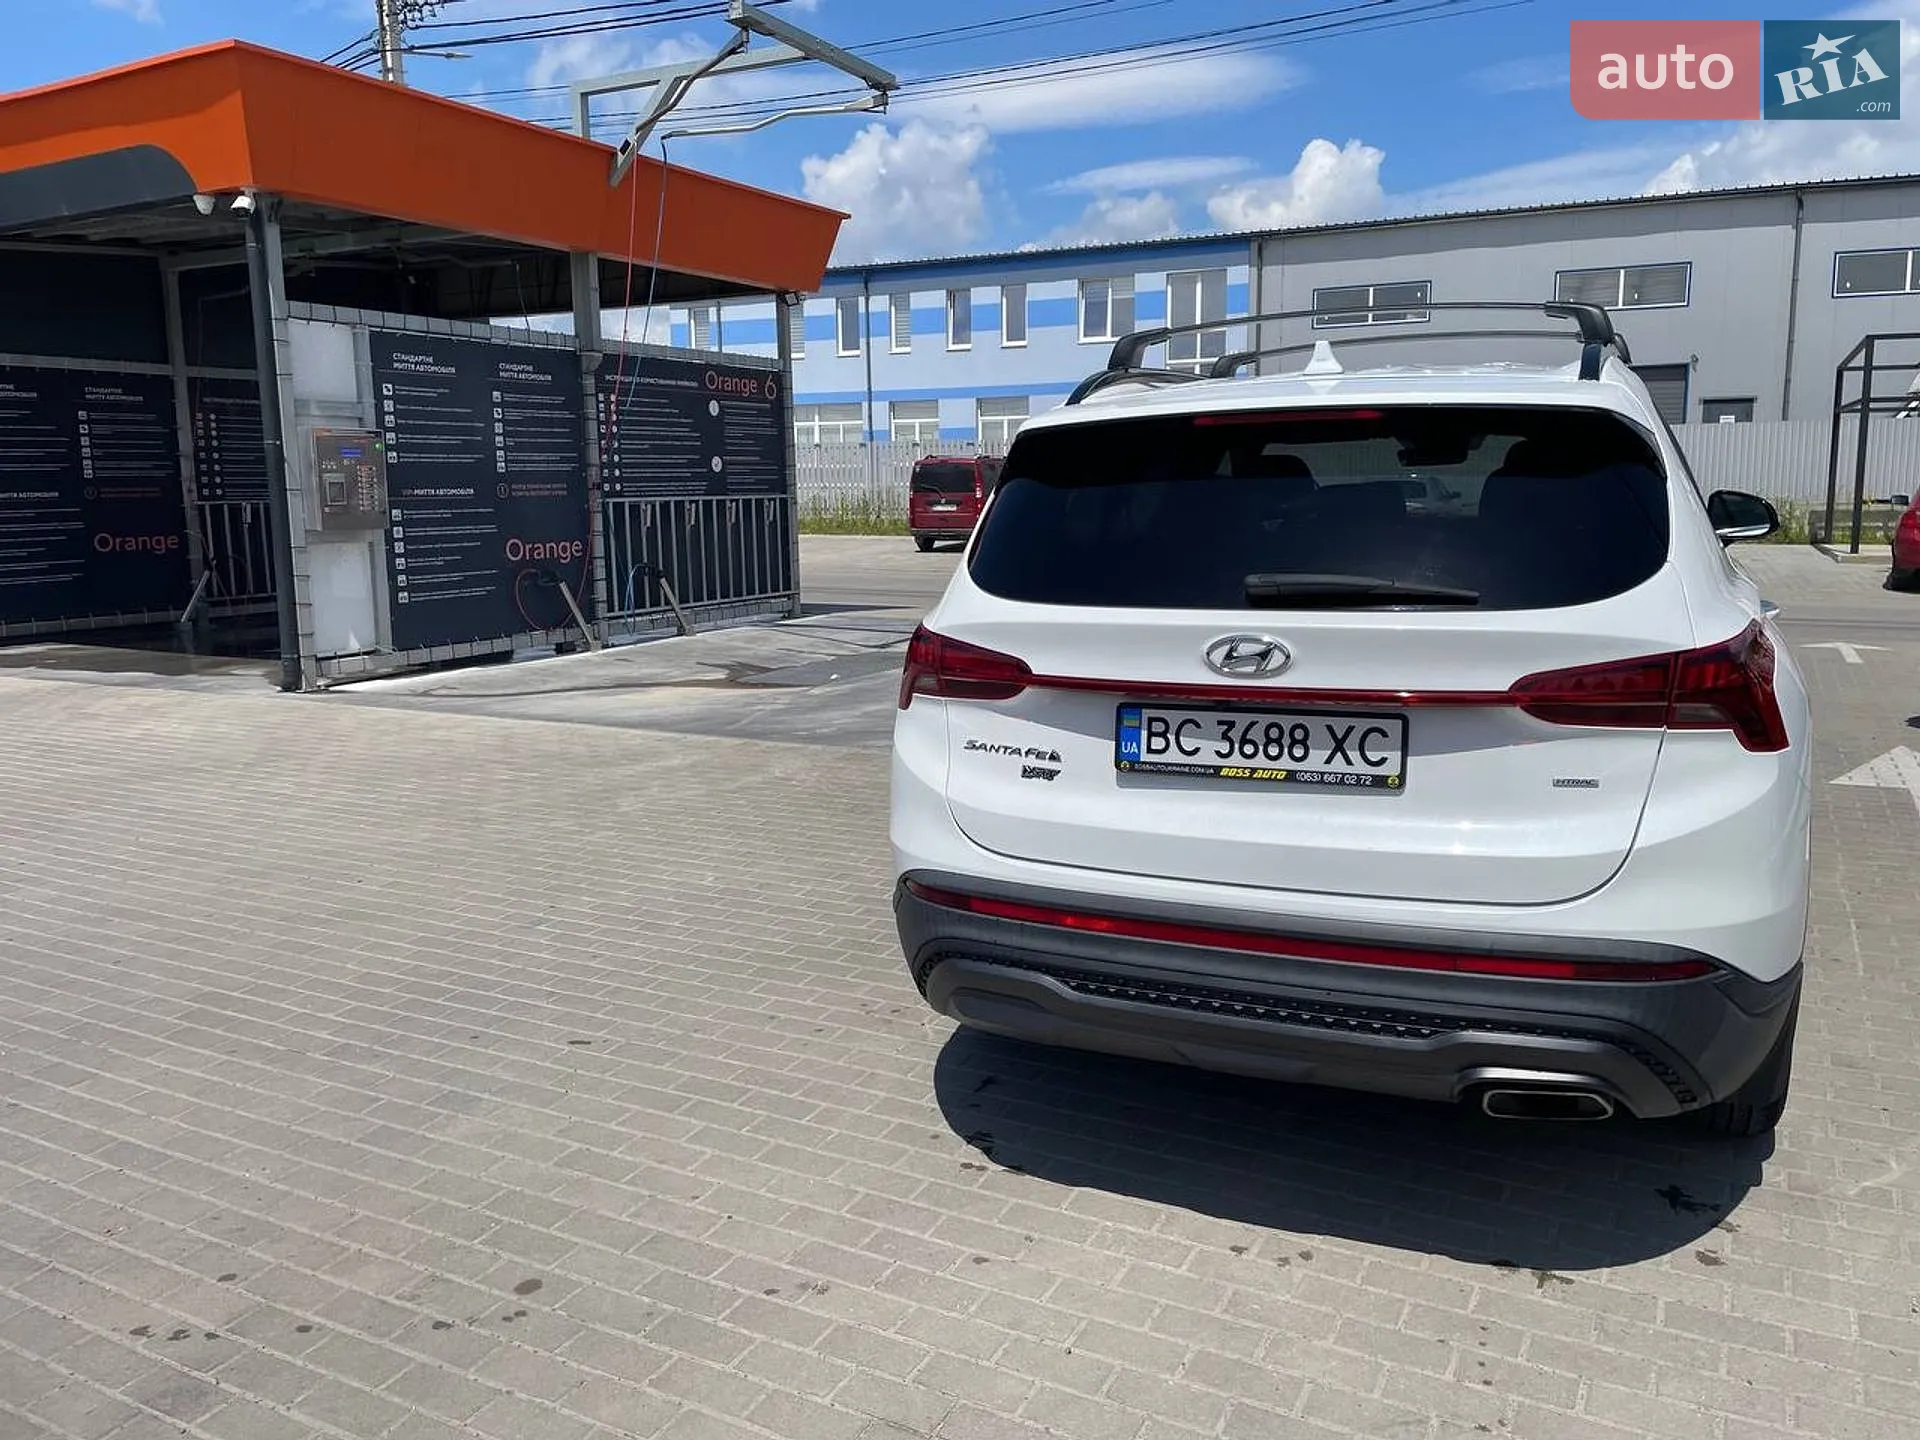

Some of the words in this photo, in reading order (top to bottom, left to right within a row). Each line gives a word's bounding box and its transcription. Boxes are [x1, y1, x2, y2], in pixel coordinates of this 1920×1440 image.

[393, 353, 433, 364] СТАНДАРТНЕ
[705, 370, 758, 397] Orange
[765, 374, 777, 399] 6
[94, 533, 180, 555] Orange
[506, 538, 583, 563] Orange
[963, 739, 1022, 758] SANTA
[1024, 747, 1049, 761] FE
[1122, 741, 1139, 754] UA
[1146, 716, 1202, 757] BC
[1214, 719, 1311, 762] 3688
[1324, 724, 1390, 768] XC
[1220, 767, 1251, 778] BOSS
[1252, 769, 1288, 780] AUTO
[1344, 773, 1358, 784] 02
[1359, 775, 1373, 786] 72
